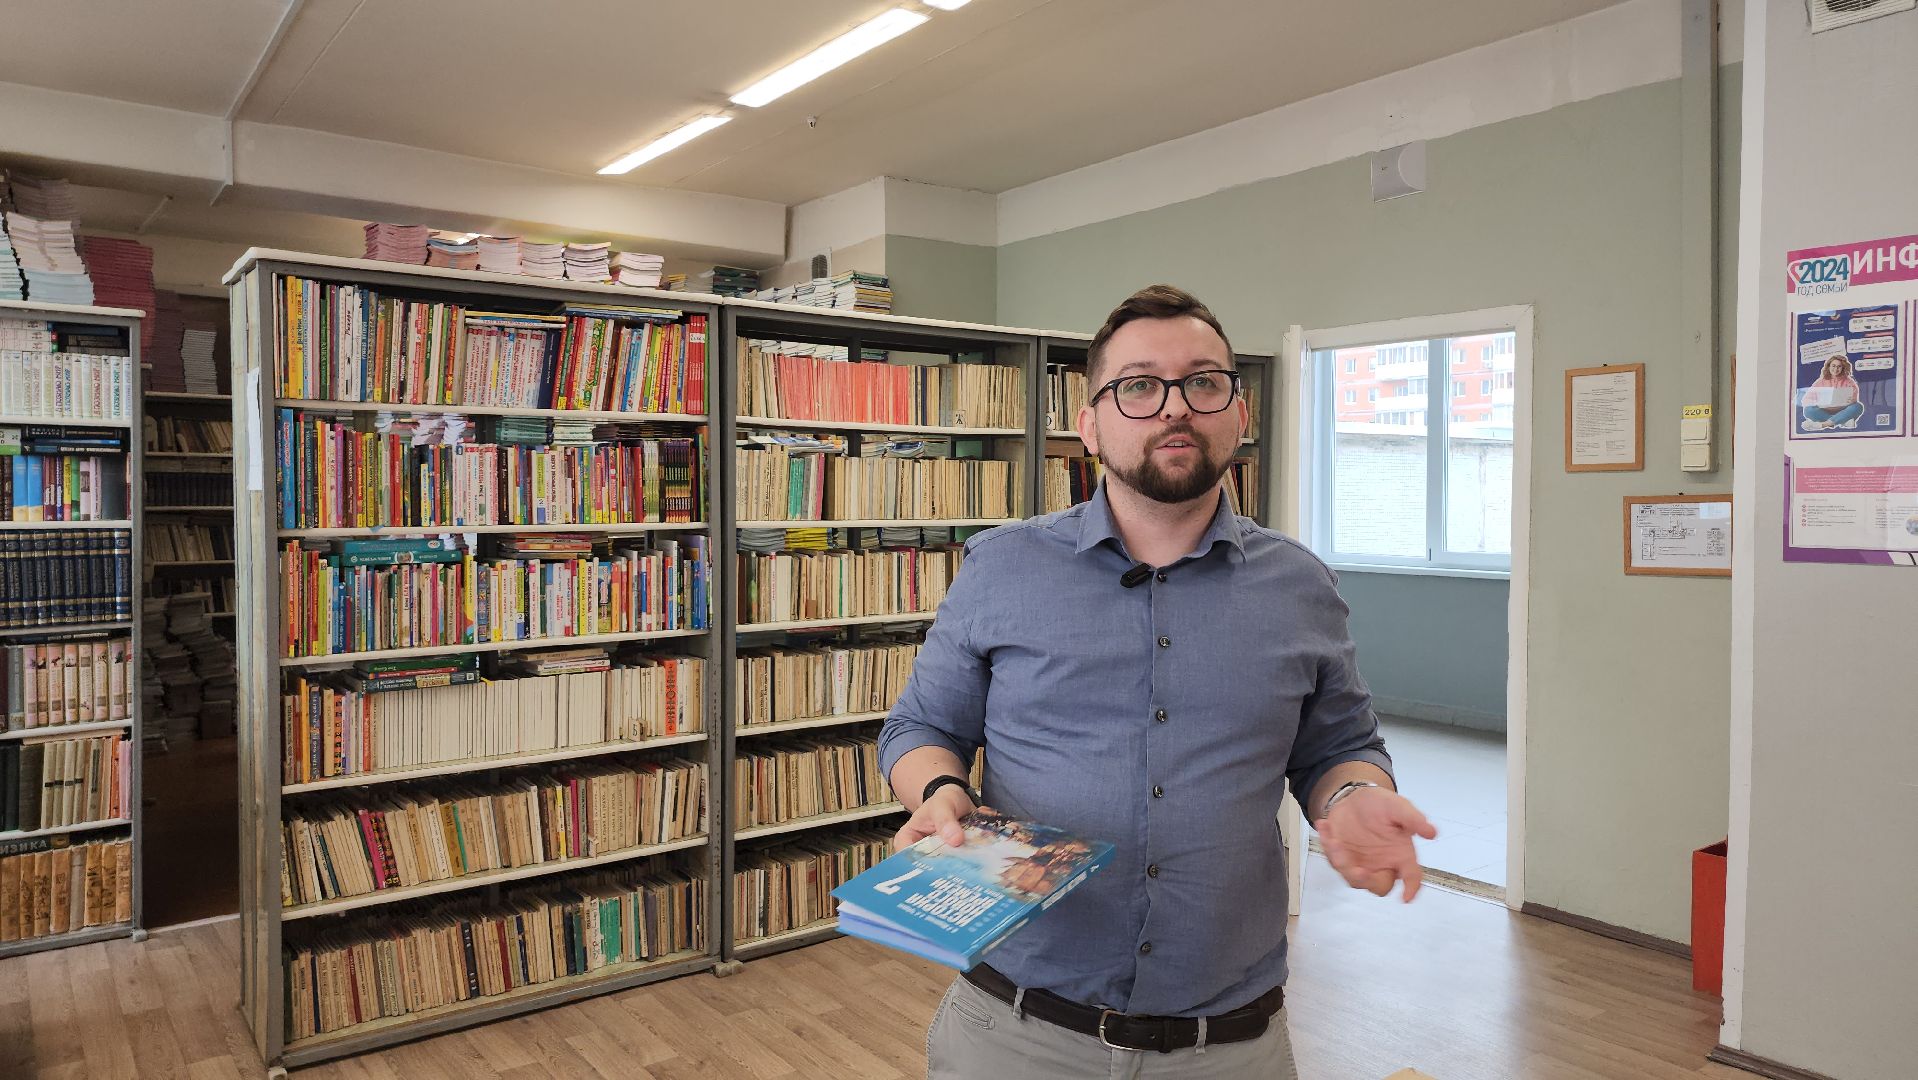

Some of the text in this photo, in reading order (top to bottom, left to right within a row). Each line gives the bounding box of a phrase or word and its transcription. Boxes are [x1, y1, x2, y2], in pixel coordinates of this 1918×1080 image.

[1799, 257, 1849, 284] 2024
[1853, 242, 1918, 275] ИНФ
[873, 867, 926, 895] 7
